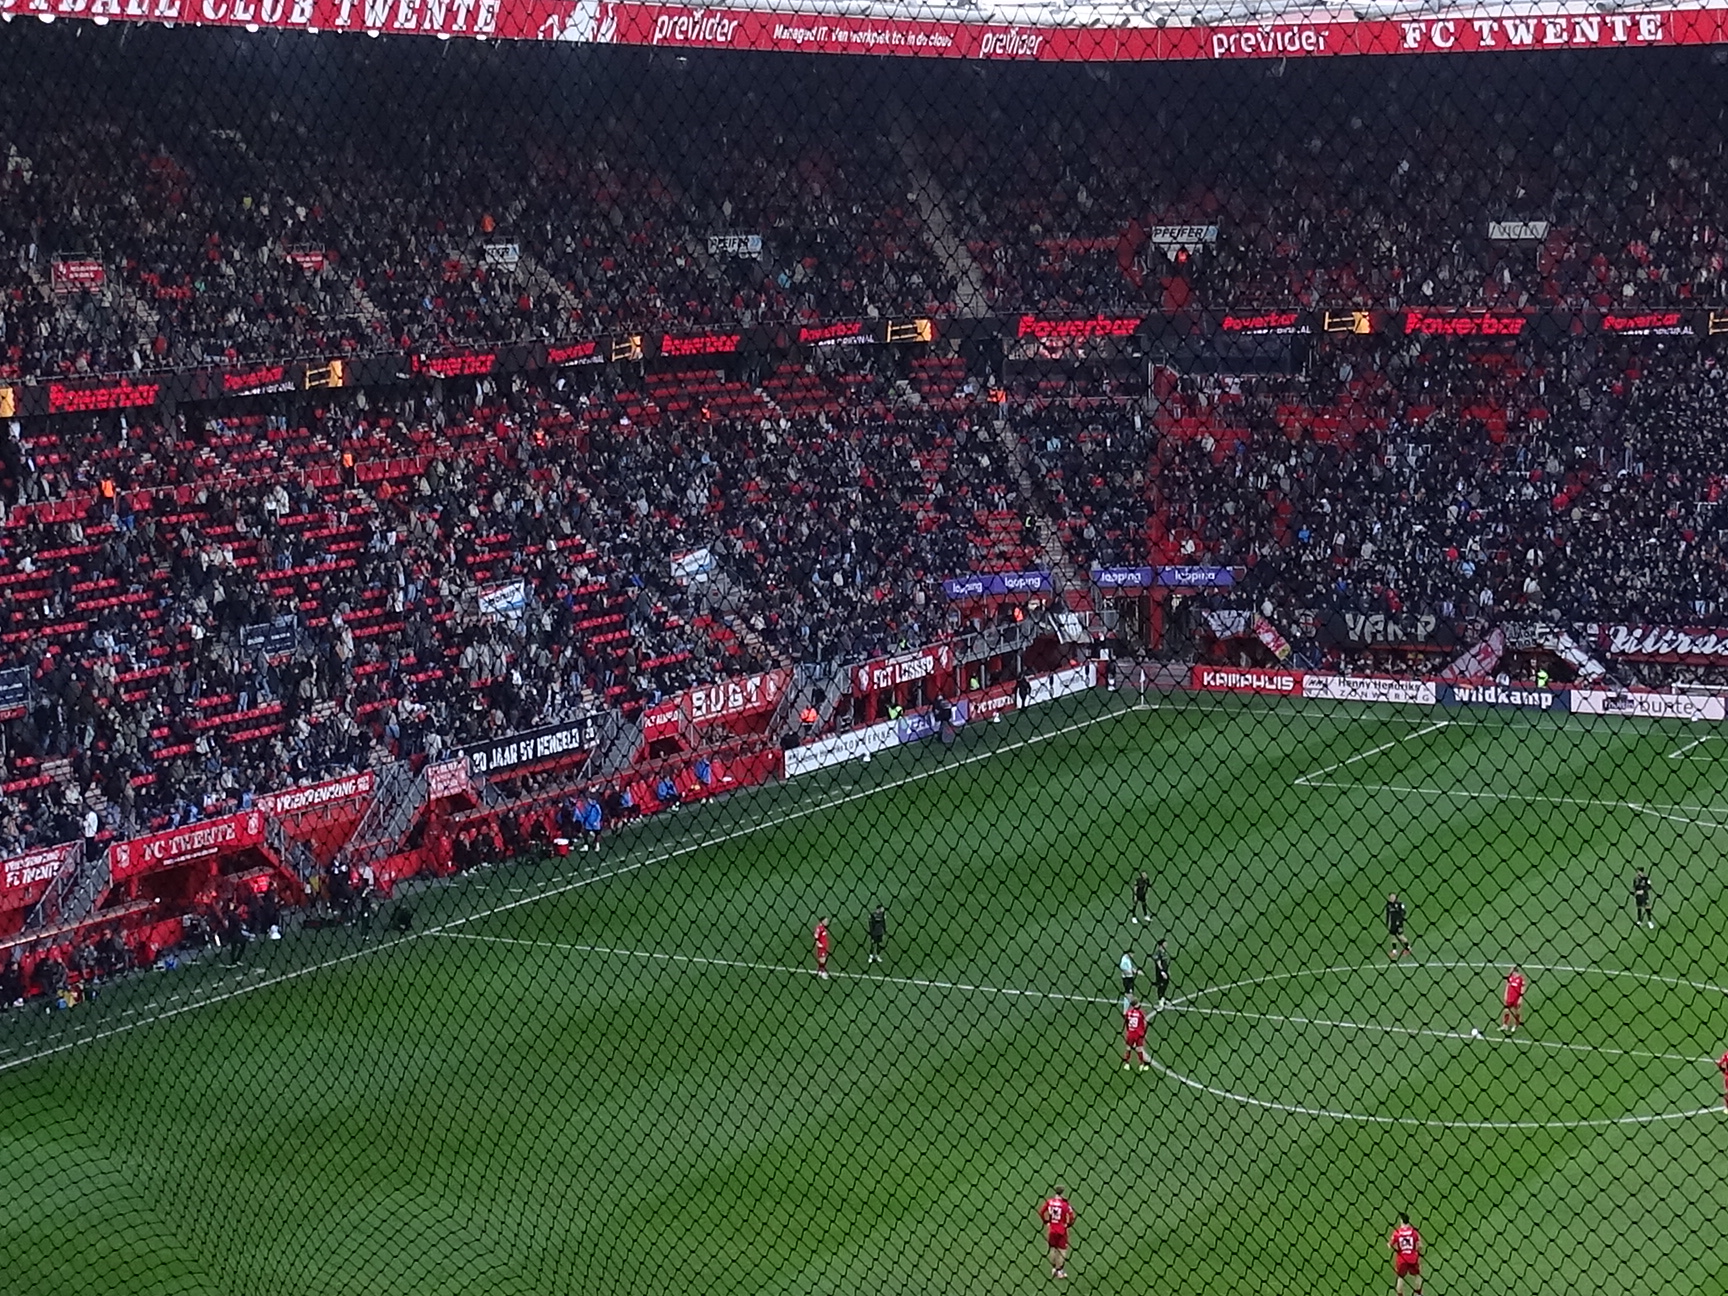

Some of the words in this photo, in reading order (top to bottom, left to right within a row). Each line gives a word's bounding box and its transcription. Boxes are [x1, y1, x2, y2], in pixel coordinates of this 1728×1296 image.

[1402, 19, 1456, 50] FC
[1471, 12, 1664, 48] TWENTE
[1017, 314, 1141, 338] Powerbar
[1404, 312, 1527, 336] Powerbar
[48, 378, 160, 414] Powerbar
[1005, 575, 1041, 590] looping
[1101, 571, 1141, 584] looping
[1202, 671, 1294, 691] KAMPHUIS
[1453, 686, 1553, 710] wildkamp
